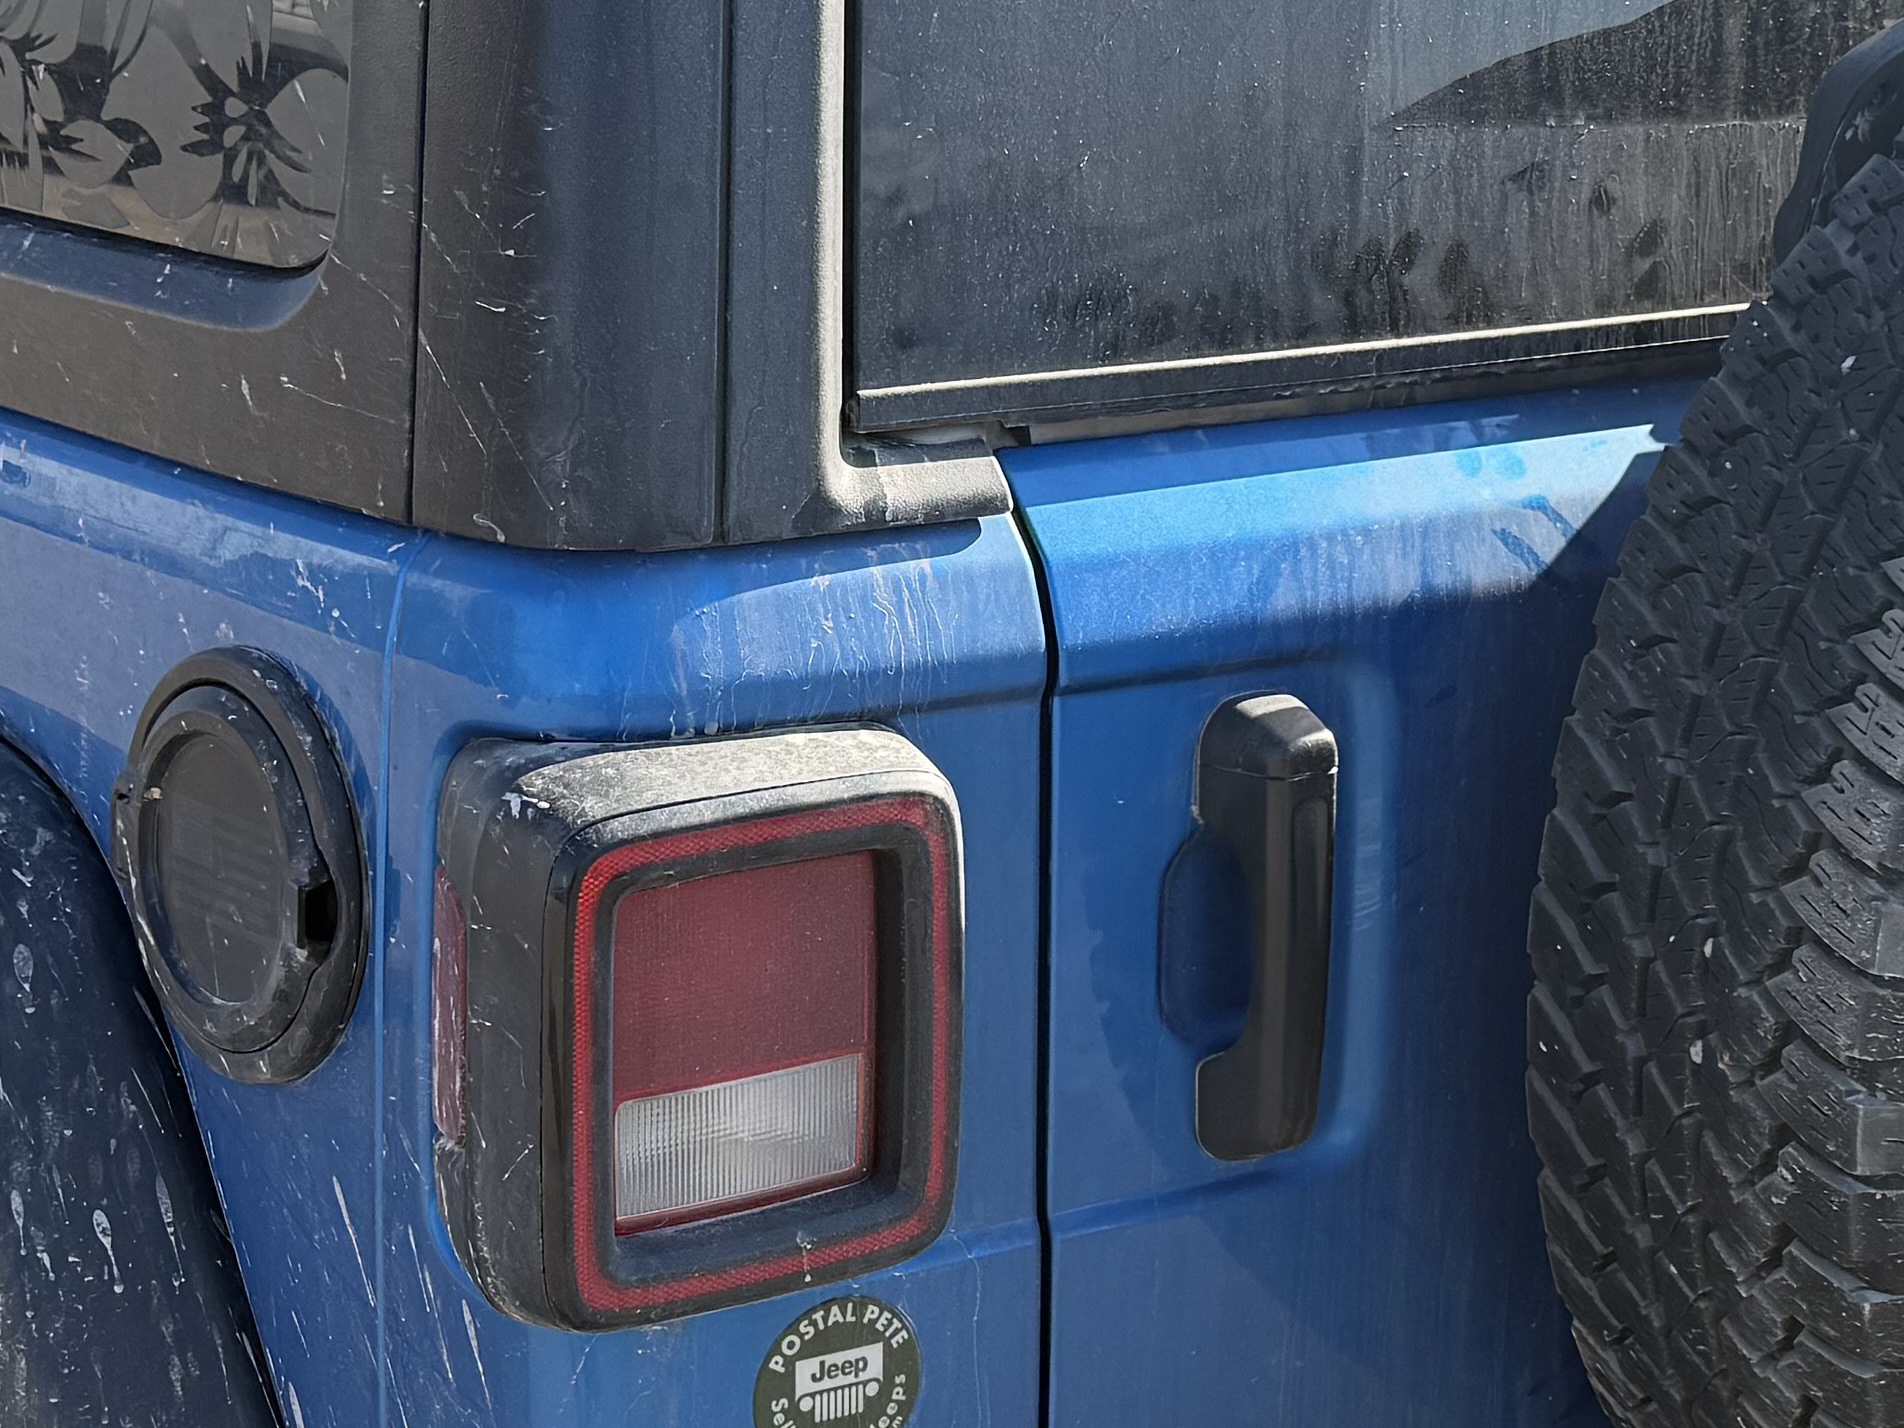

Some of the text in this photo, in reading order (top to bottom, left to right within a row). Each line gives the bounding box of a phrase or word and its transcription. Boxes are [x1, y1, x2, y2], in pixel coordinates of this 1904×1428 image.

[768, 1302, 909, 1373] POSTAL PETE
[810, 1355, 868, 1383] Jeep
